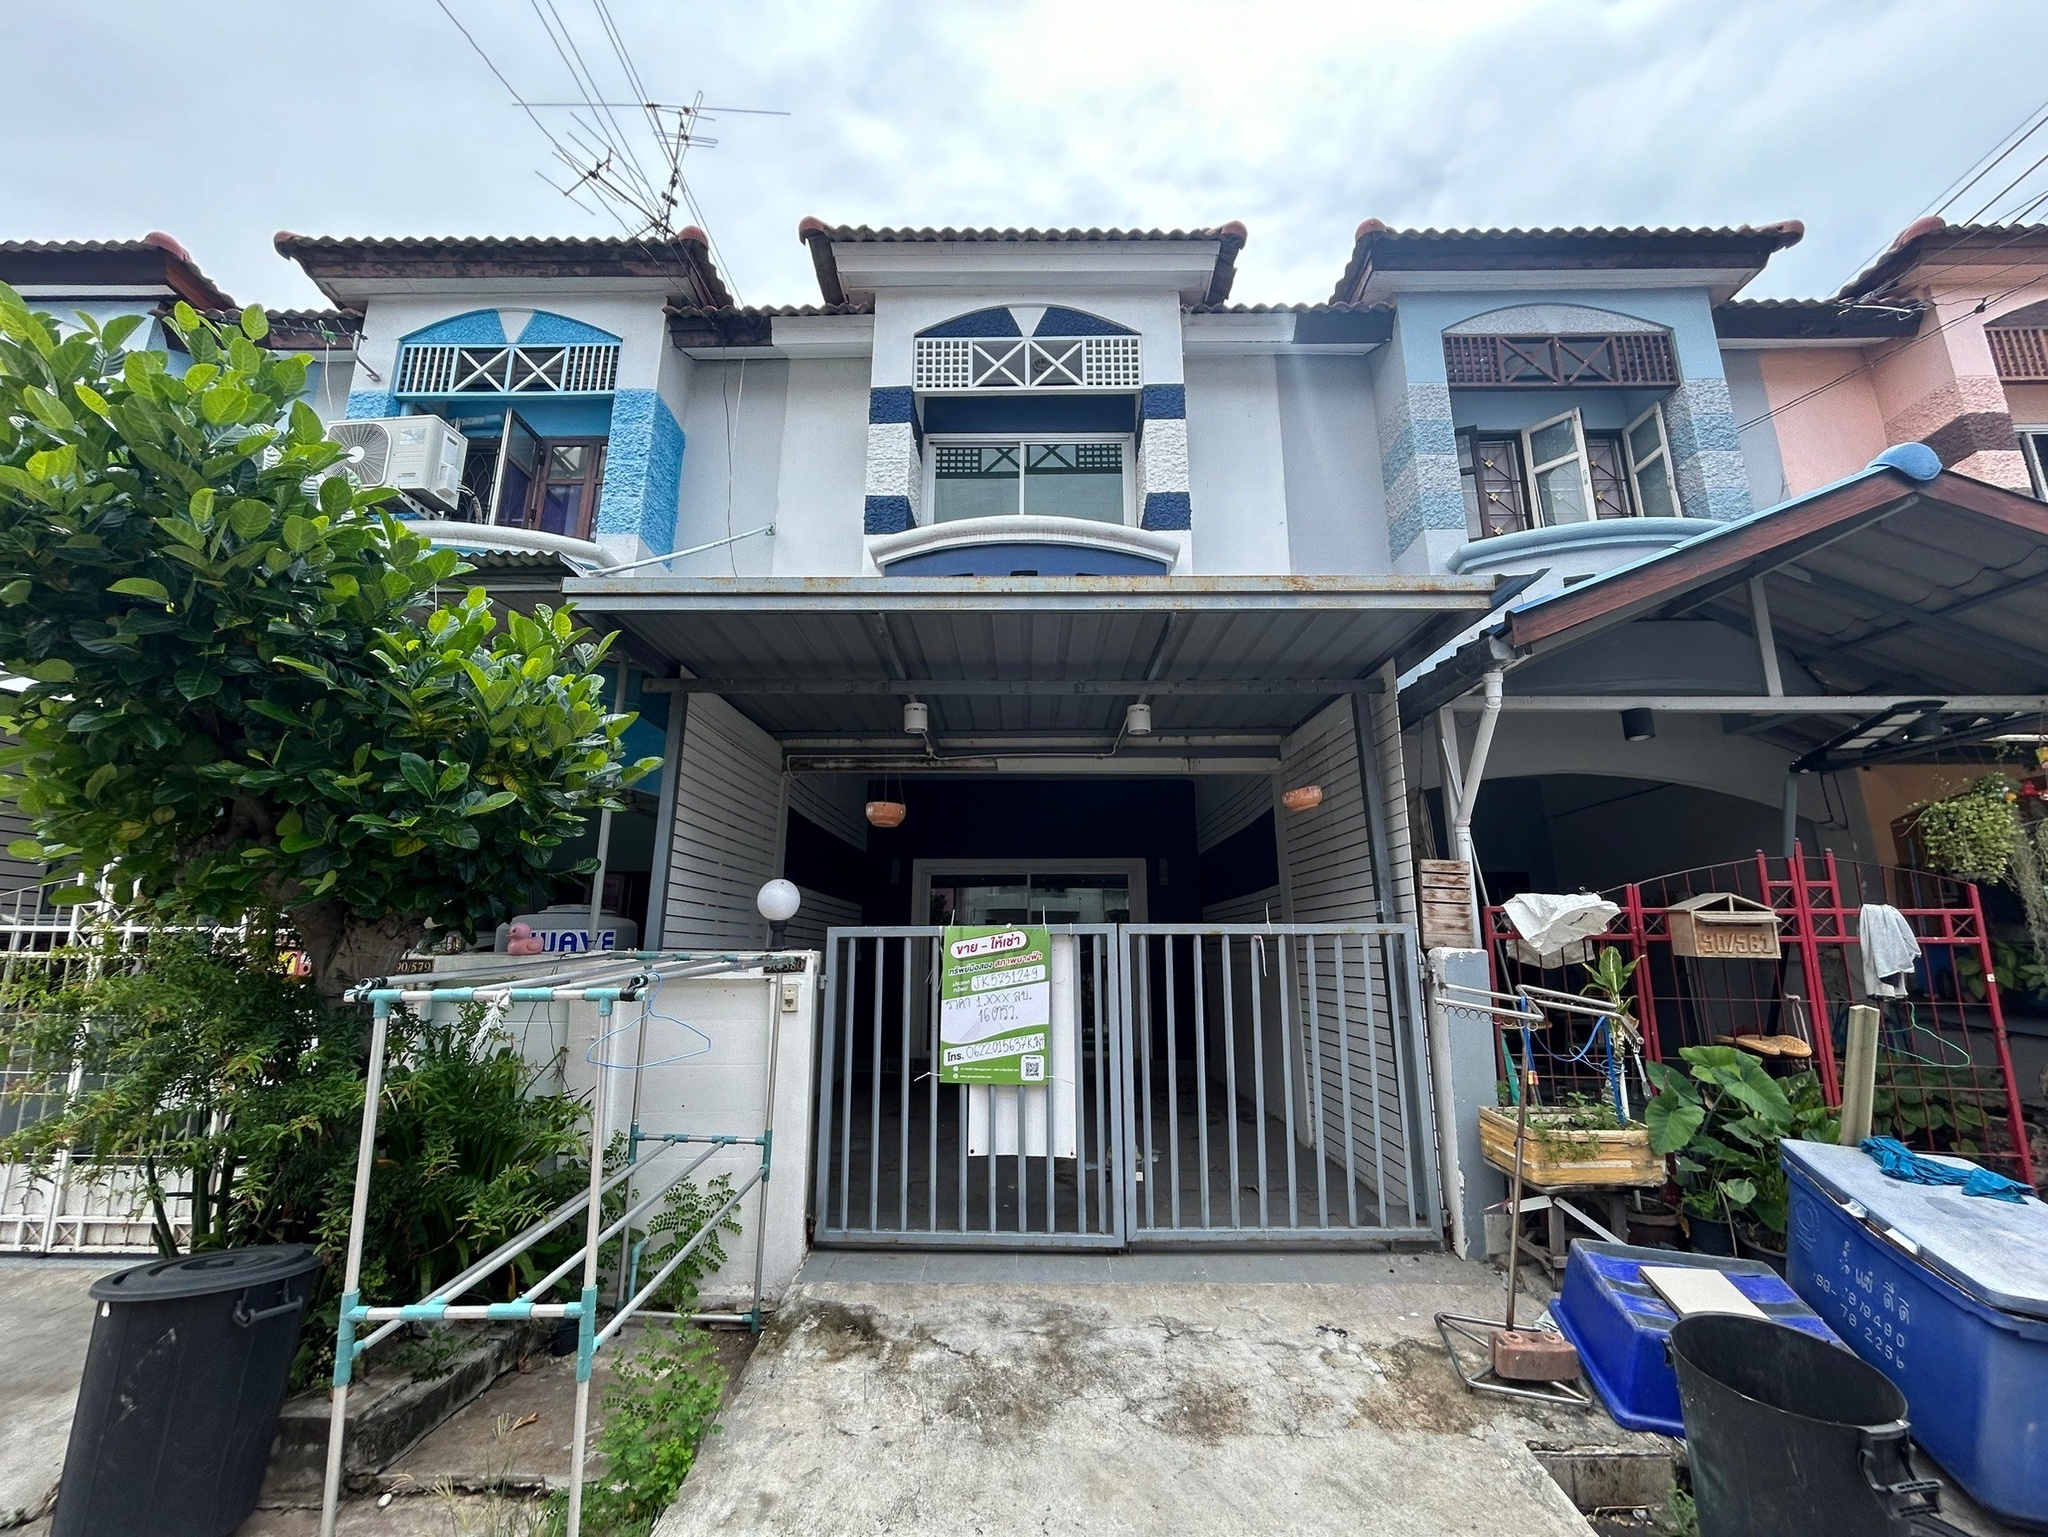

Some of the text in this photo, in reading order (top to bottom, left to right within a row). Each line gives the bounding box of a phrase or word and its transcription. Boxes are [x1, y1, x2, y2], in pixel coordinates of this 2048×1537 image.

[530, 931, 614, 951] WAVE
[956, 943, 978, 955] ขาย
[990, 933, 1020, 950] ให้เช่า
[974, 967, 1038, 989] JK5731249
[945, 997, 971, 1010] ราคา
[947, 1051, 965, 1062] โทร.
